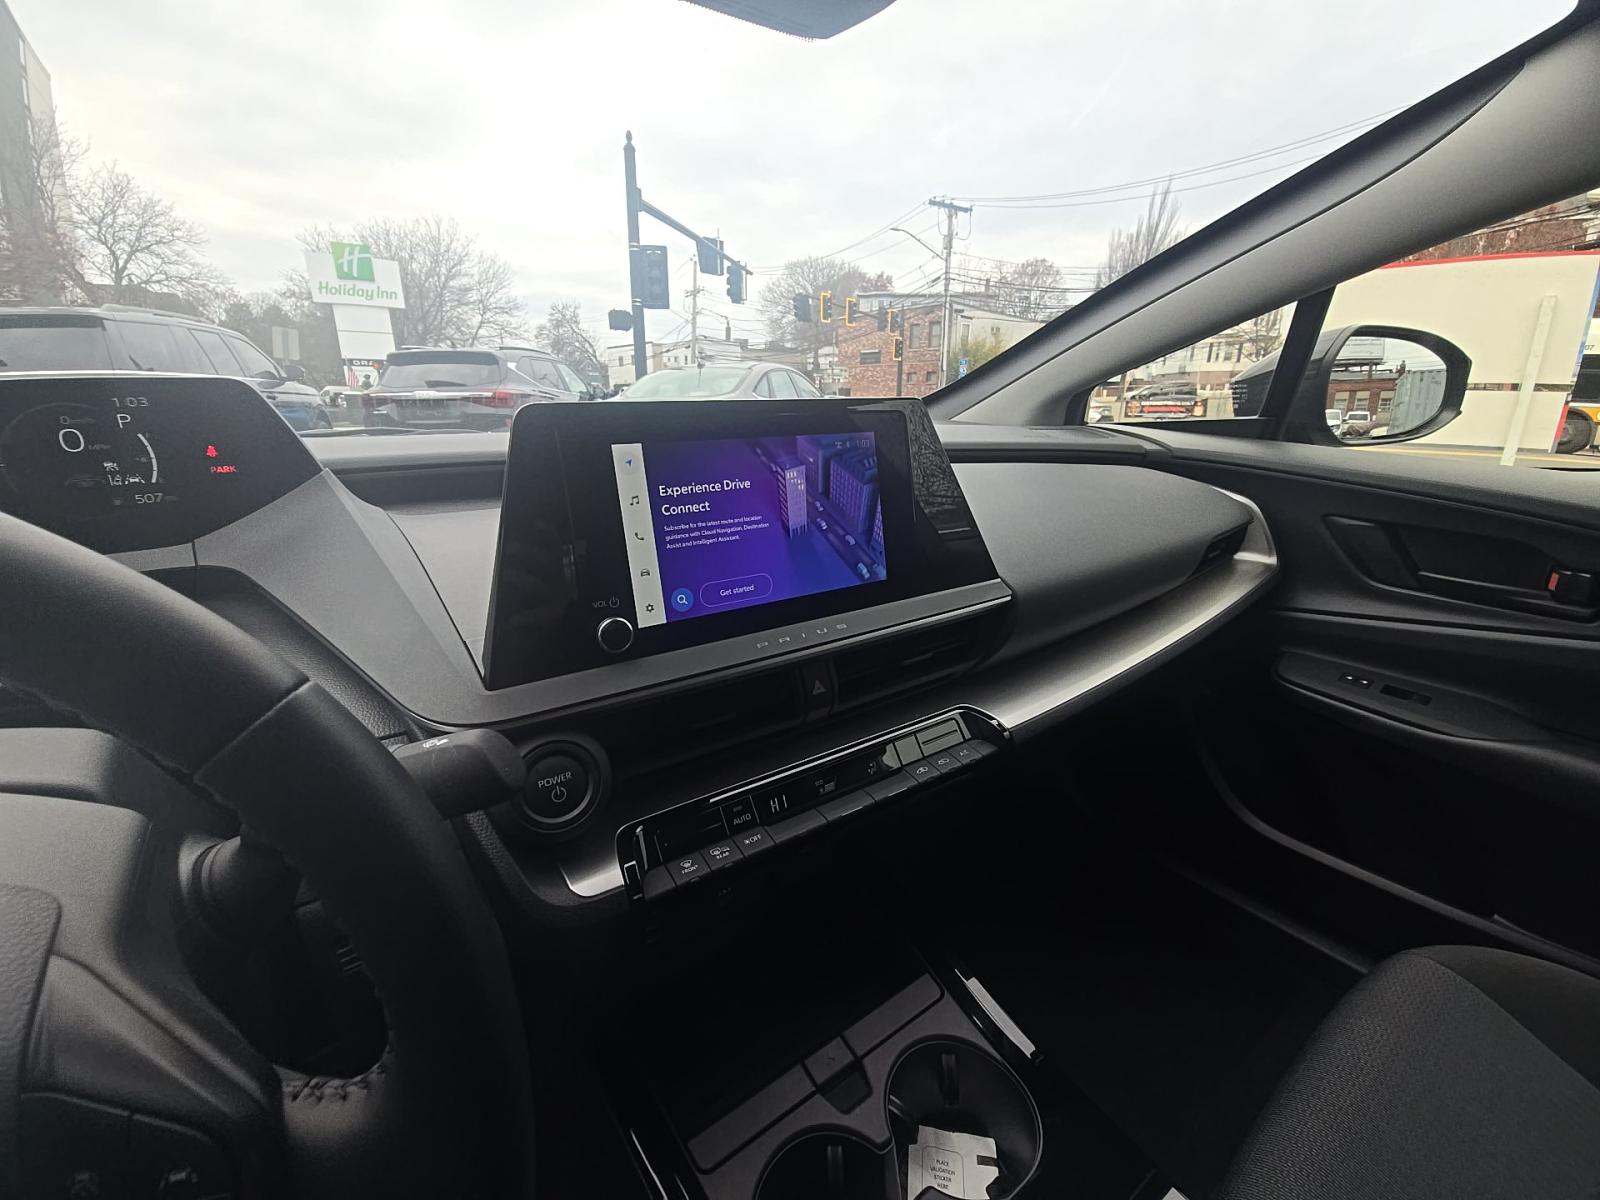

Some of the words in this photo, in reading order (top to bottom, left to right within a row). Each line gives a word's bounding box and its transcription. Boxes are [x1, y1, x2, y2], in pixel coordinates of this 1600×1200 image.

[319, 281, 375, 300] Holiday
[377, 286, 398, 300] Inn
[116, 413, 131, 429] P
[58, 428, 85, 452] 0
[210, 465, 238, 473] PARK
[659, 483, 722, 497] Experience
[723, 479, 751, 490] Drive
[135, 493, 163, 504] 507
[661, 501, 711, 515] Connect
[664, 523, 690, 531] Subscribe
[665, 533, 690, 541] guidance
[690, 530, 701, 538] with
[693, 537, 718, 546] Intelligent
[733, 585, 755, 594] started
[593, 600, 608, 608] VOL
[537, 771, 573, 788] POWER
[733, 813, 752, 826] AUTO
[681, 864, 699, 875] FRONT
